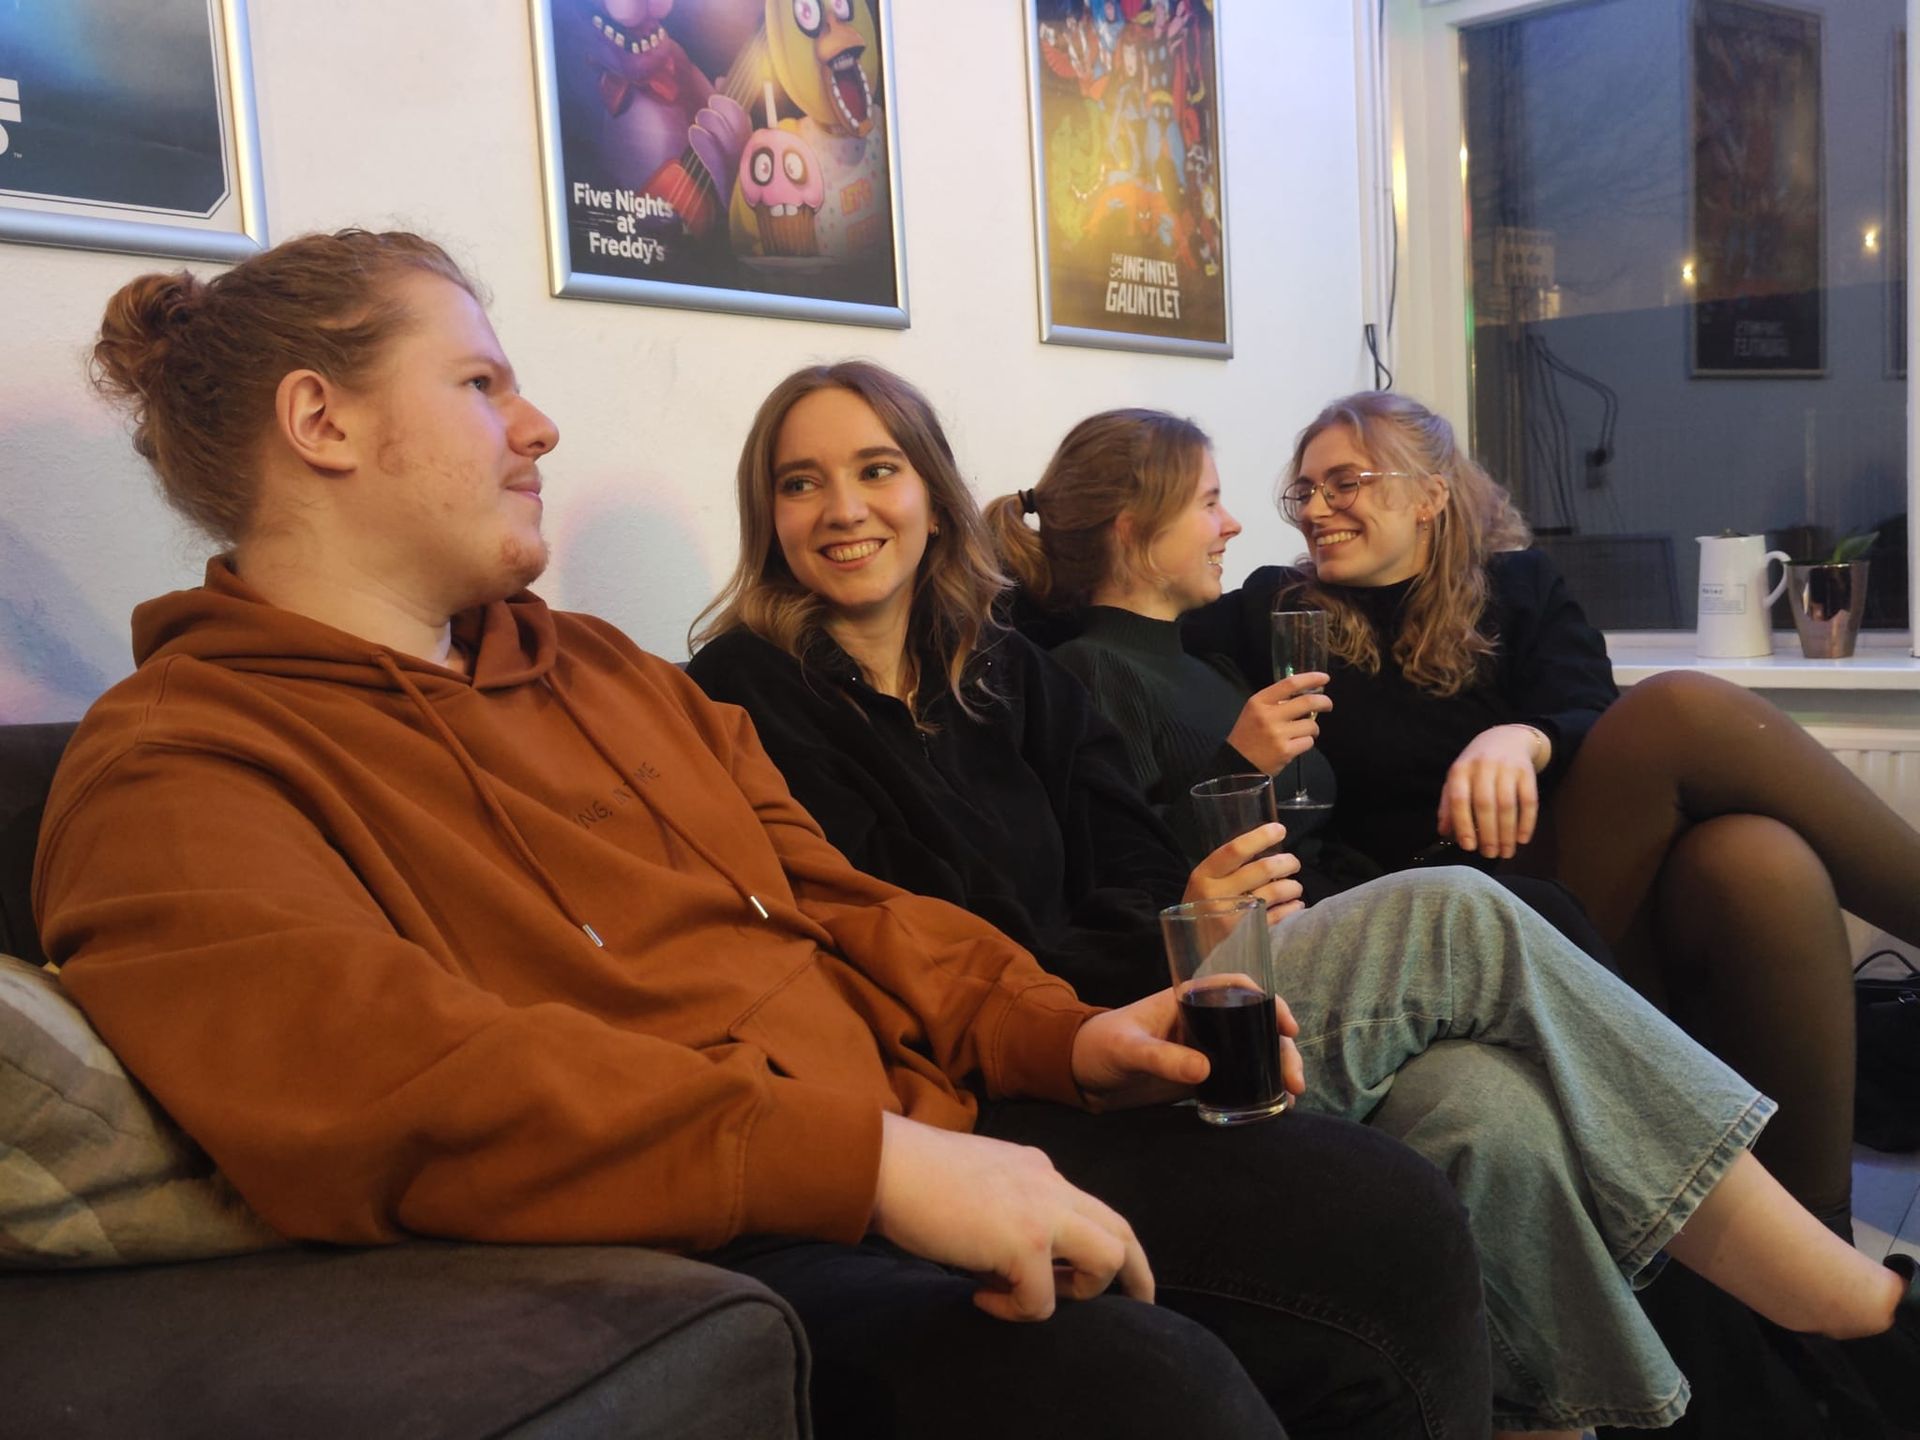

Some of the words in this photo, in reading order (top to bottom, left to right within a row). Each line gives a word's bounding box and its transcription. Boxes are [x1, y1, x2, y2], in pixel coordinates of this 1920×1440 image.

[573, 182, 612, 210] Five
[615, 189, 674, 221] Nights
[616, 213, 636, 235] at
[588, 232, 666, 265] Freddy's
[1122, 254, 1179, 287] INFINITY
[1105, 280, 1180, 320] GAUNTLET
